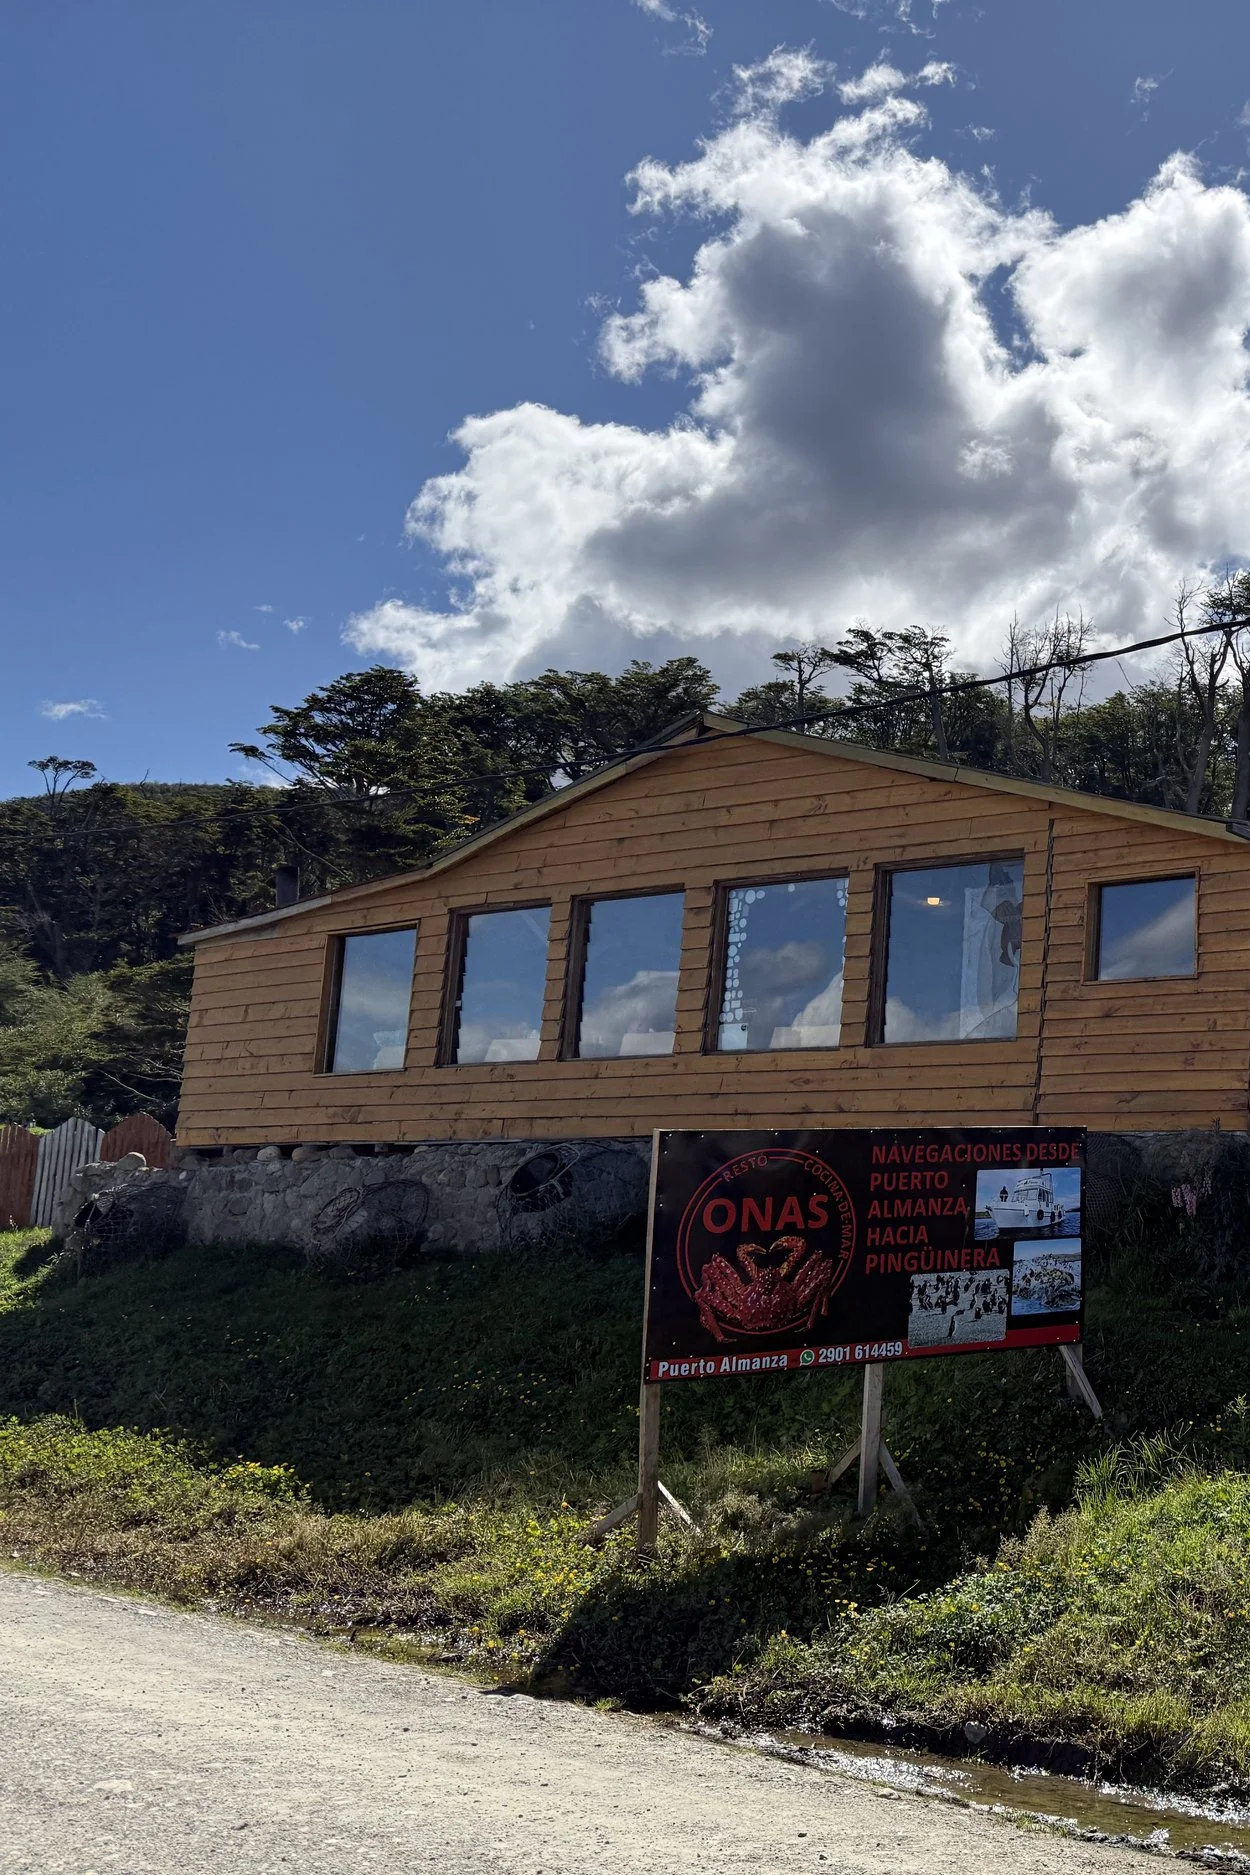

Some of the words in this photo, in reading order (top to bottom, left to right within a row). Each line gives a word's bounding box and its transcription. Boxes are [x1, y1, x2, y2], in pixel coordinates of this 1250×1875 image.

[722, 1152, 769, 1183] RESTÓ
[871, 1143, 1022, 1165] NAVEGACIONES
[1026, 1143, 1080, 1162] DESDE
[869, 1170, 950, 1192] PUERTO
[702, 1194, 830, 1235] ONAS
[867, 1195, 968, 1220] ALMANZA
[866, 1223, 929, 1247] HACIA
[865, 1245, 1001, 1275] PINGÜINERA
[657, 1358, 715, 1379] Puerto
[719, 1353, 789, 1373] Almanza
[818, 1346, 850, 1364] 2901
[854, 1341, 903, 1360] 614459
